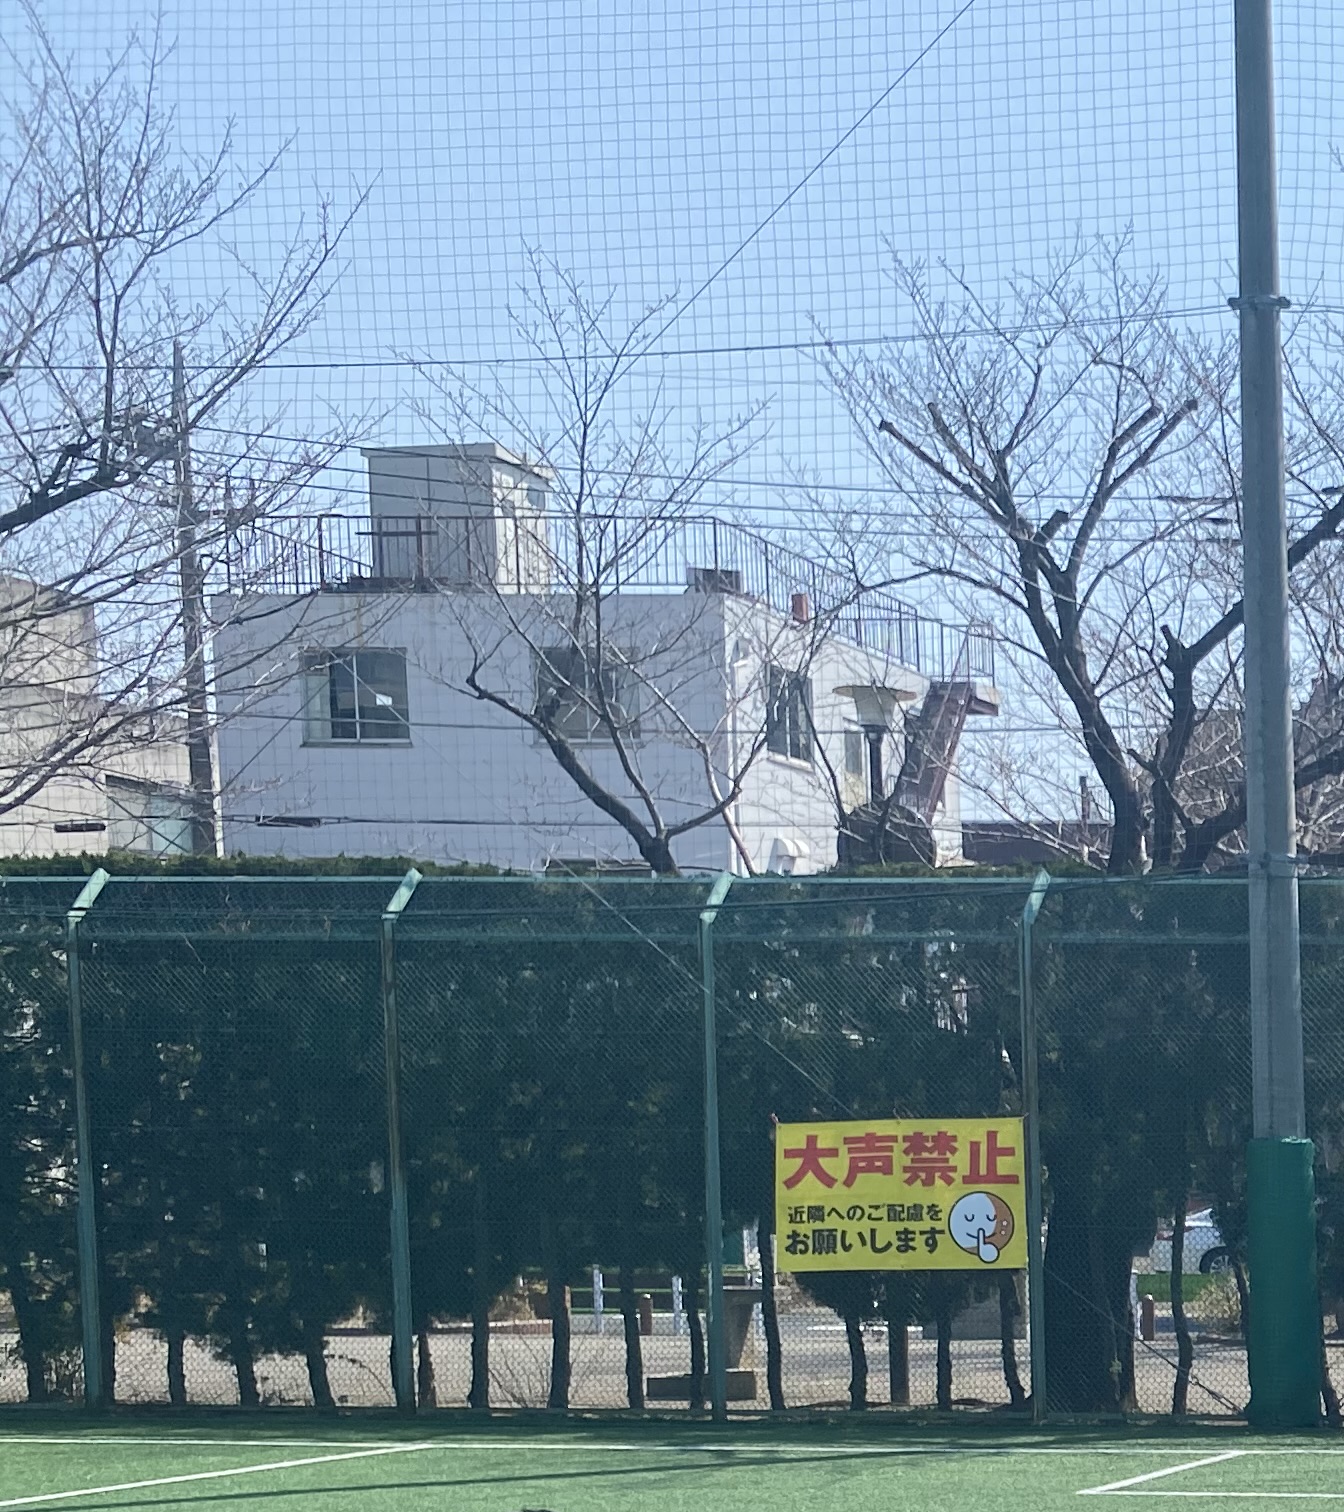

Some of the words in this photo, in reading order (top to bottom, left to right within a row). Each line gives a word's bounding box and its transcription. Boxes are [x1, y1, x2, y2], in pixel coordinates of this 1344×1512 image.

[782, 1130, 1020, 1190] 大声禁止
[787, 1203, 943, 1225] 近隣へのご配慮を
[785, 1227, 946, 1256] お願いします
